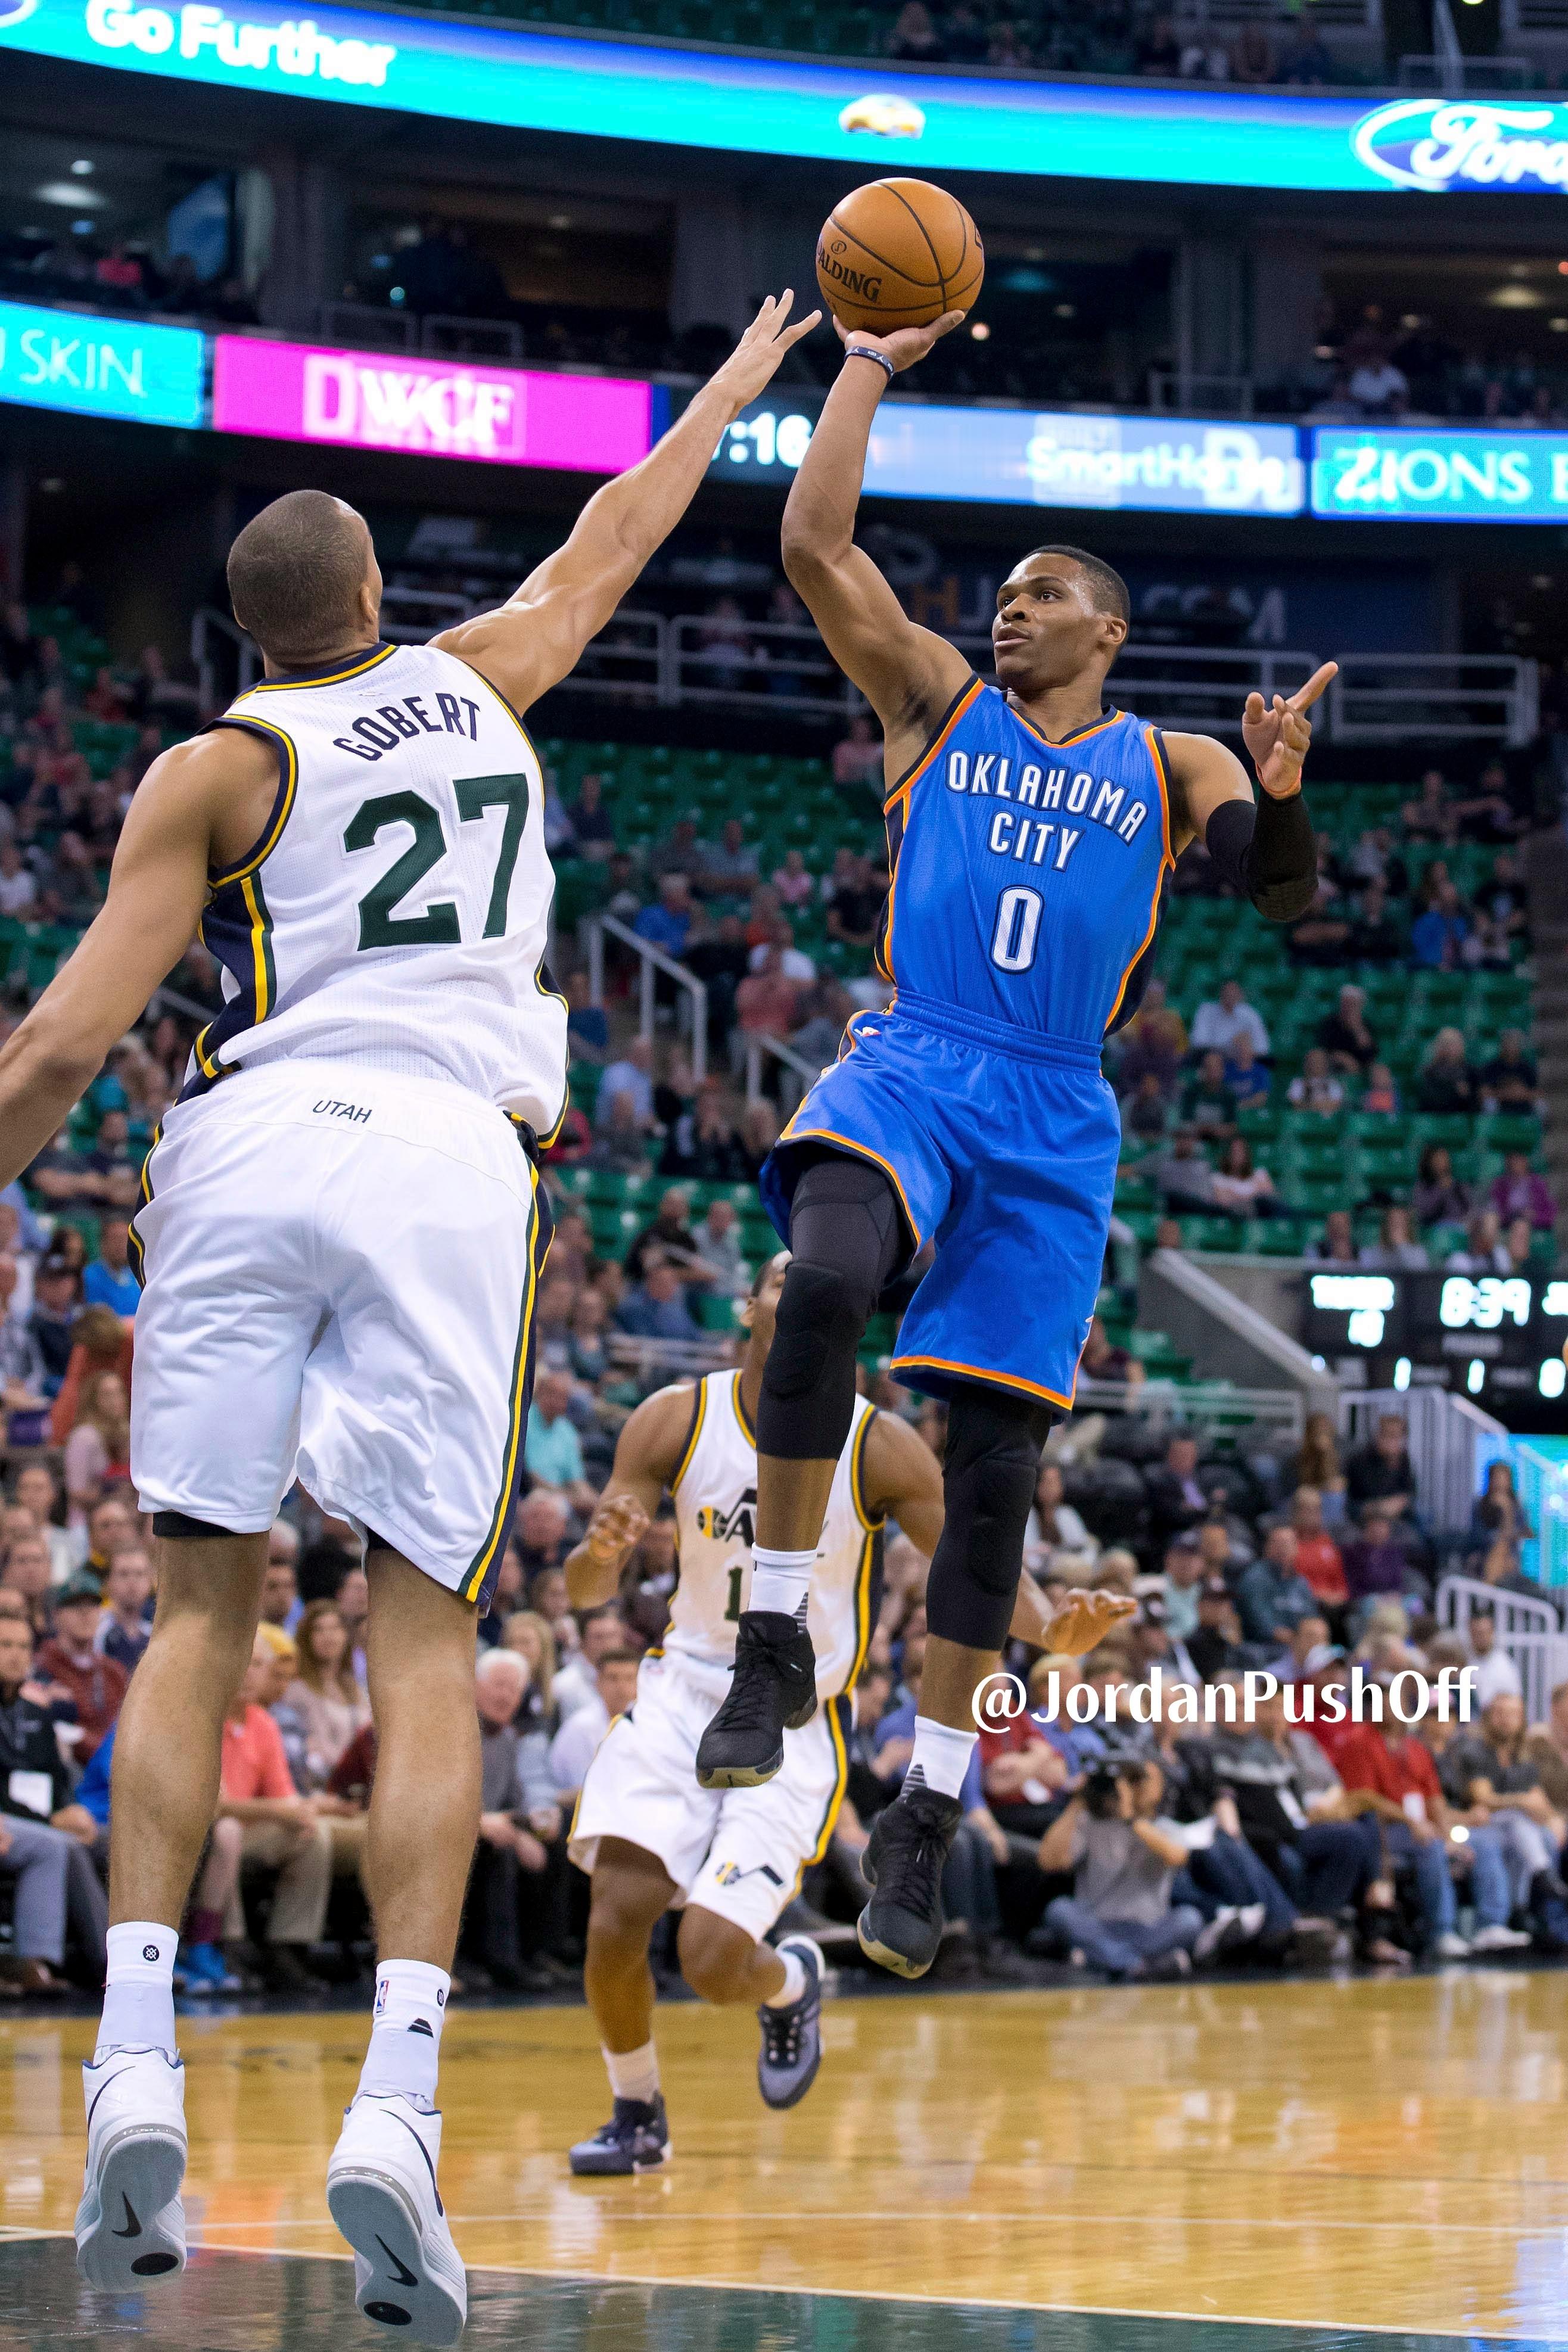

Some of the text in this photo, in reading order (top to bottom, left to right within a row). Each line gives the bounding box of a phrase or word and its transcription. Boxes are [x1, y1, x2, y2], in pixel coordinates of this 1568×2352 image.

[85, 0, 396, 87] Go Further
[19, 328, 148, 399] SKIN
[1334, 447, 1533, 504] ZIONS
[332, 693, 481, 761] GOBERT
[946, 748, 1149, 846] OKLAHOMA
[343, 772, 530, 951] 27
[987, 811, 1084, 872] CITY
[990, 884, 1044, 973] 0
[312, 1100, 372, 1124] UTAH
[1440, 1276, 1531, 1327] 8:39
